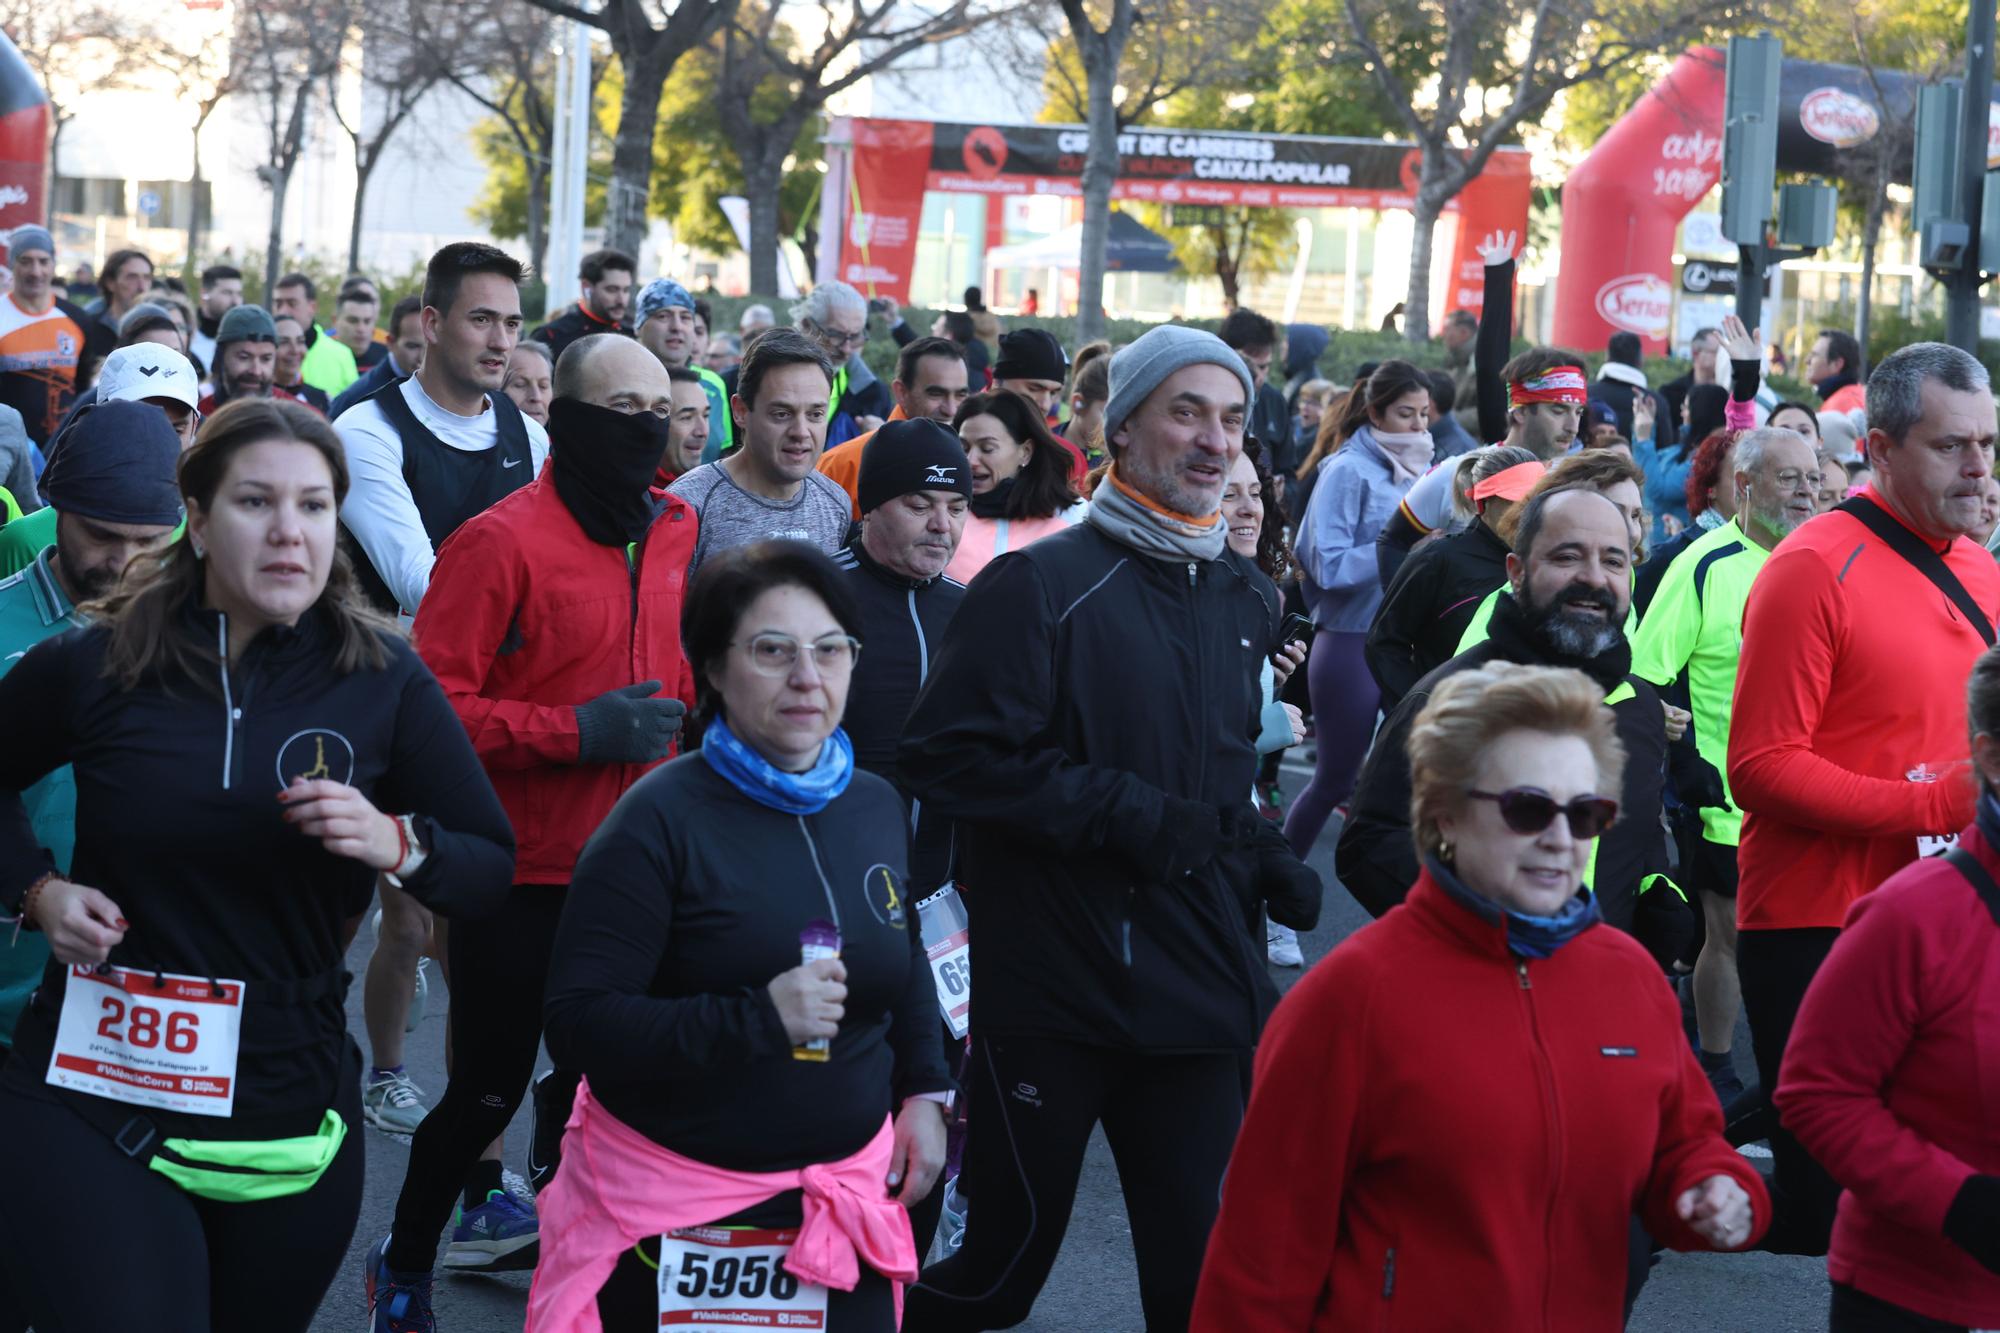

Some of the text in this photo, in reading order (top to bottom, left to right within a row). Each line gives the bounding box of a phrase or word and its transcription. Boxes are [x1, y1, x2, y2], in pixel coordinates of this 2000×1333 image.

[1058, 131, 1275, 161] CIRIT DE CARRERES
[97, 996, 200, 1055] 286
[676, 1252, 799, 1300] 5958
[691, 1311, 772, 1325] #ValènciaCorre
